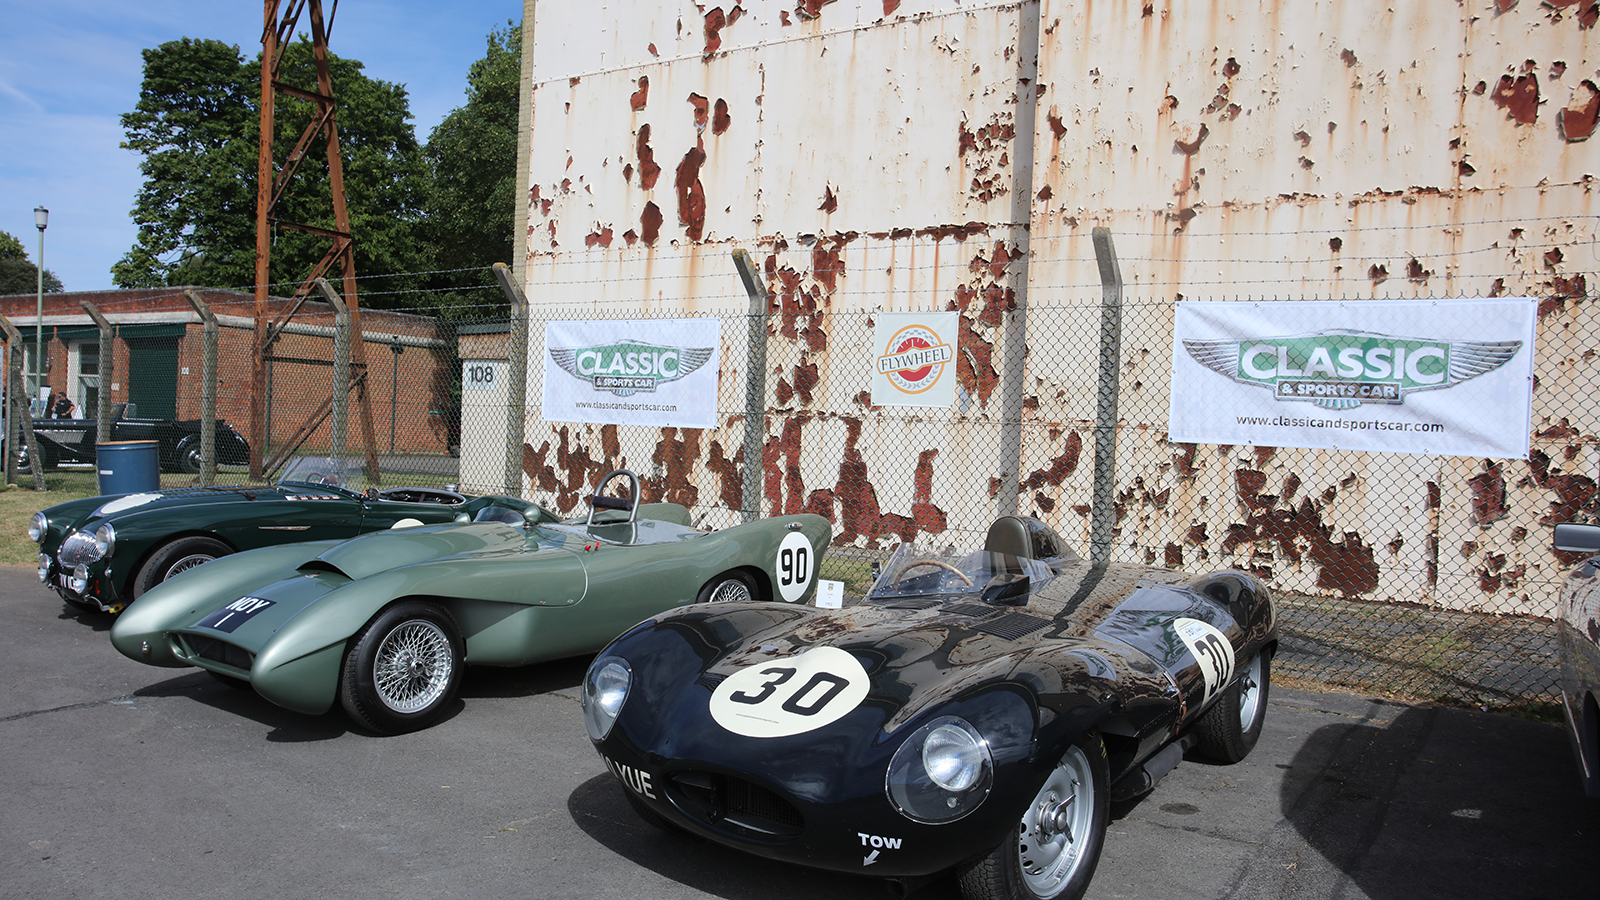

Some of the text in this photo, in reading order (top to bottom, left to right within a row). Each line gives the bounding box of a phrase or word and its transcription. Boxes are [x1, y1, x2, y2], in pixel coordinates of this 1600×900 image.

[576, 350, 679, 378] CLASSIC
[881, 348, 949, 371] FLYWHEEL
[1241, 343, 1446, 384] CLASSIC
[468, 366, 494, 383] 108
[596, 378, 653, 388] & SPORTS CAR
[1281, 383, 1396, 398] & SPORTS CAR
[575, 401, 678, 412] www.classicandsportscar.com
[1235, 414, 1445, 433] www.classicandsportscar.com
[781, 547, 807, 586] 90
[225, 596, 270, 614] NOY
[1194, 633, 1229, 698] 30
[729, 667, 850, 717] 30
[614, 760, 657, 800] YUE
[857, 832, 902, 850] TOW
